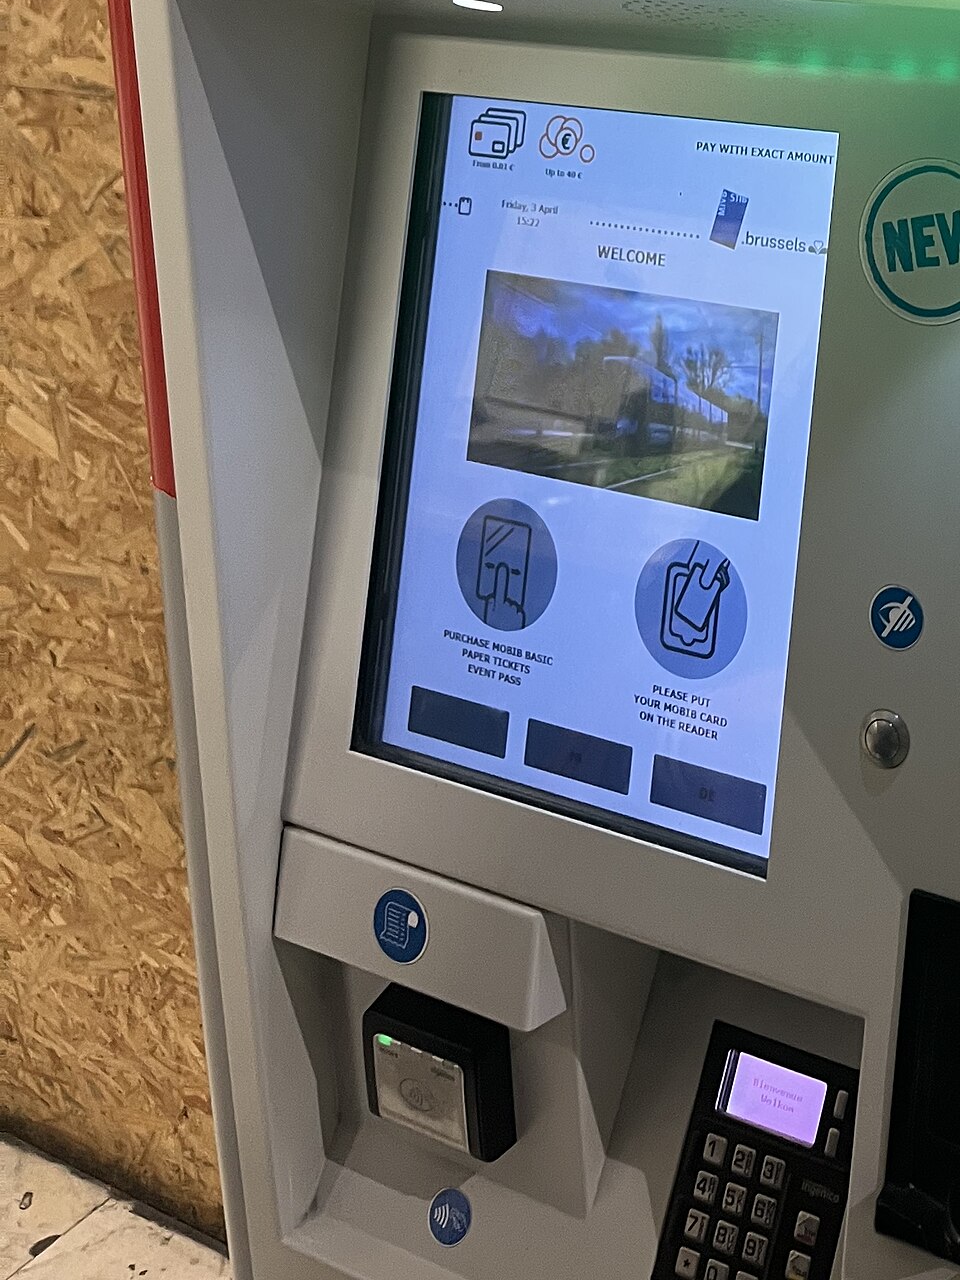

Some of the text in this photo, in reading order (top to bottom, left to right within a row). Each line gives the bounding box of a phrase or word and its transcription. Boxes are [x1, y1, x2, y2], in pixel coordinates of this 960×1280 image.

[696, 141, 835, 165] PAY WITH EXACT AMOUNT
[538, 204, 559, 215] April
[741, 231, 806, 252] .brussels
[597, 245, 666, 267] WELCOME
[443, 629, 553, 666] PURCHASE MOBIB BASIC
[462, 648, 531, 674] PAPER TICKETS
[467, 664, 521, 686] EVENT PASS
[652, 684, 711, 708] PLEASE PUT
[633, 694, 728, 727] YOUR MOBIB CARD
[639, 711, 718, 741] ON THE READER
[708, 1139, 717, 1157] 1
[734, 1150, 744, 1168] 2
[763, 1161, 774, 1179] 3
[696, 1177, 706, 1195] 4
[725, 1187, 736, 1207] 5
[754, 1199, 765, 1219] 6
[687, 1214, 699, 1232] 7
